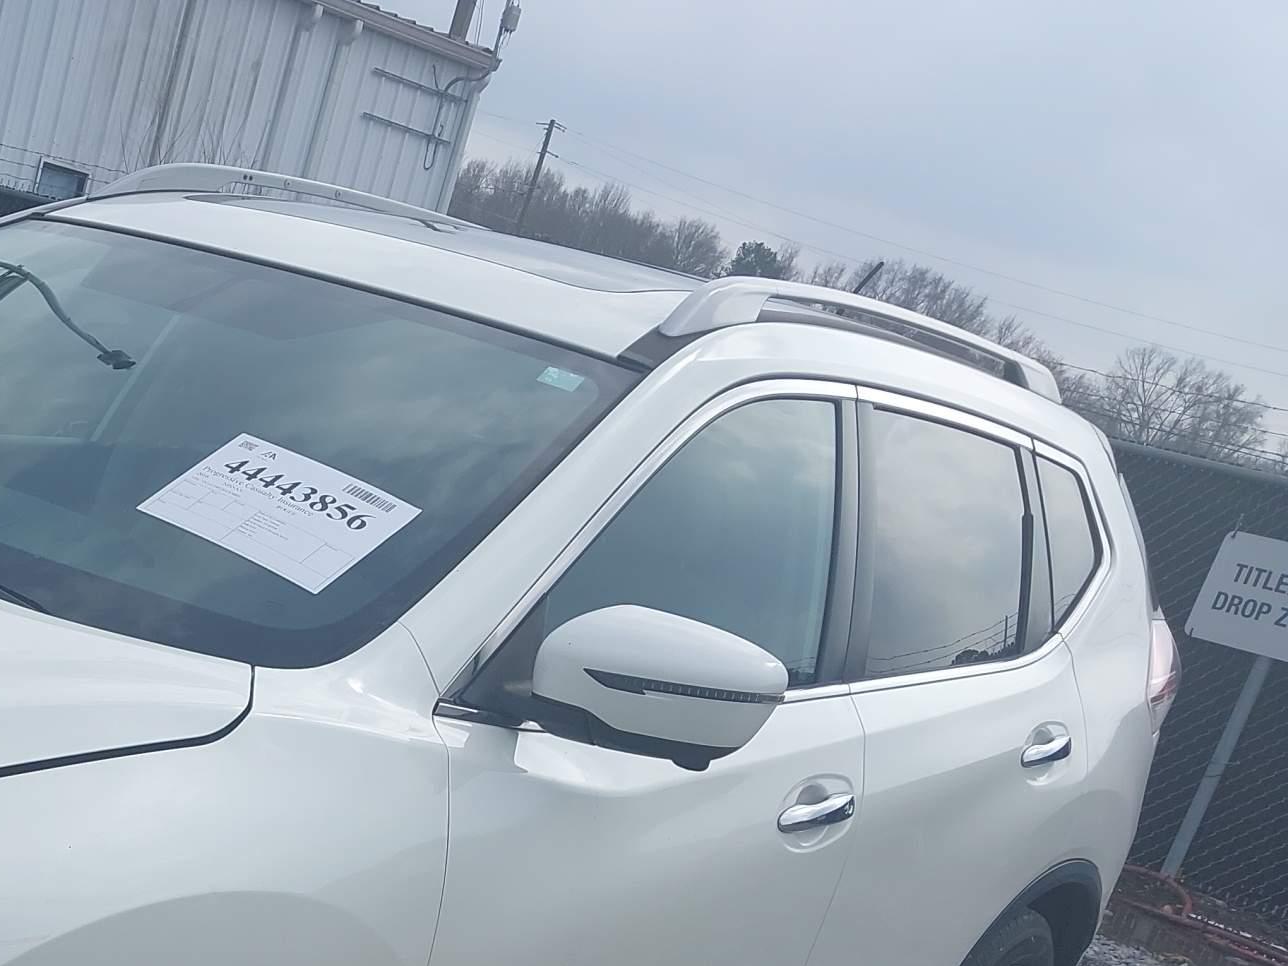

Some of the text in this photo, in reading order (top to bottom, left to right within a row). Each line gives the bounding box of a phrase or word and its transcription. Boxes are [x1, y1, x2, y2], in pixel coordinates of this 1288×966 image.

[223, 459, 376, 531] 44443856
[276, 496, 314, 517] Insurance
[1212, 591, 1272, 620] DROP
